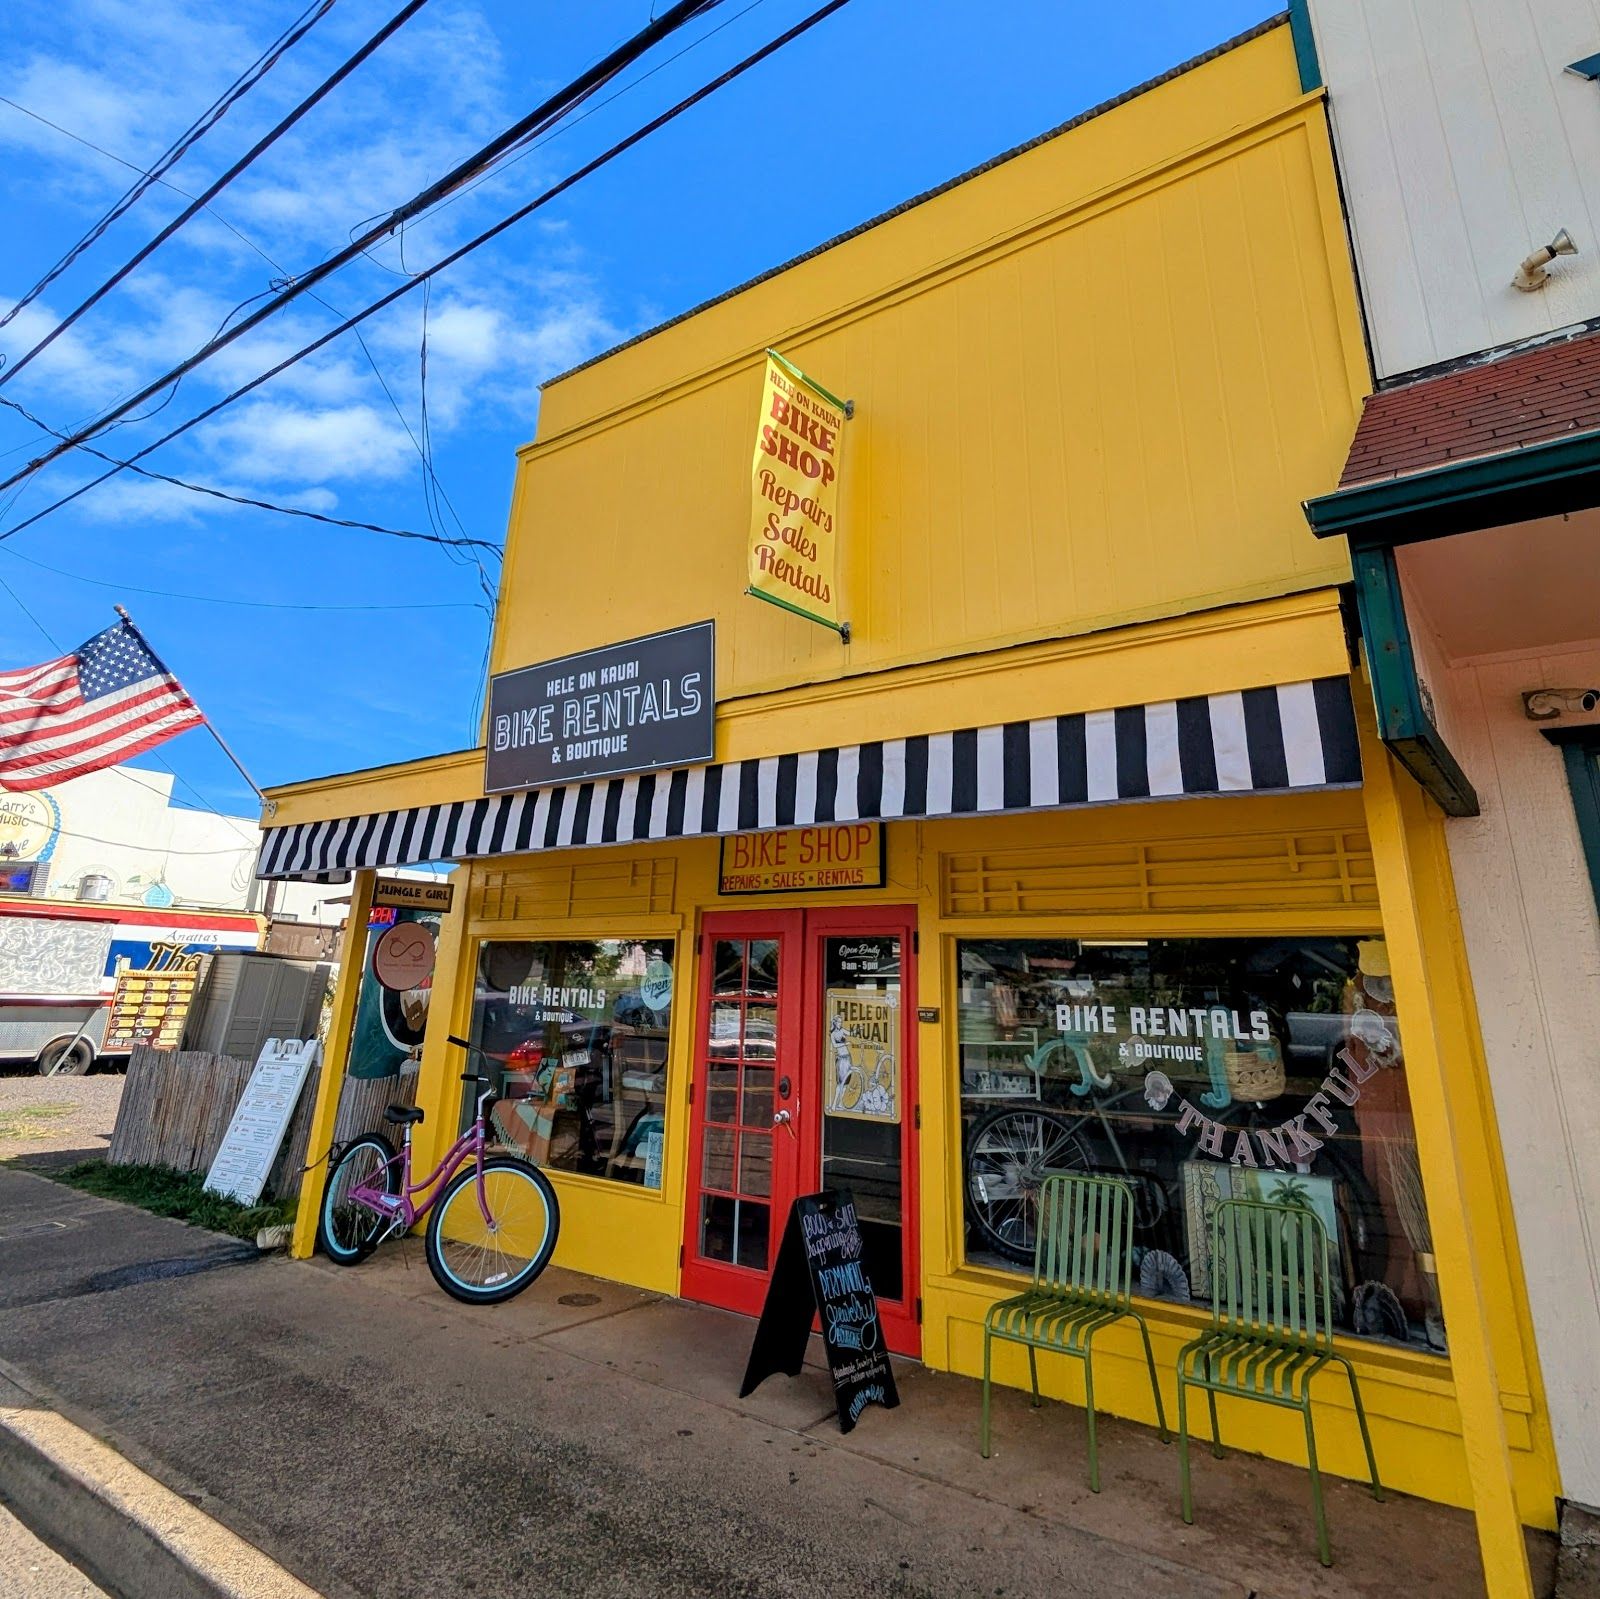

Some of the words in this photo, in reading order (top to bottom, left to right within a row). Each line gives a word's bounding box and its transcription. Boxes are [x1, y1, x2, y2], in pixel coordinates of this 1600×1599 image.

[770, 370, 796, 399] HELE
[796, 391, 811, 411] ON
[812, 401, 842, 431] KAUAI
[770, 391, 836, 457] BIKE
[760, 424, 835, 488] SHOP
[759, 469, 833, 534] Repairs
[763, 512, 817, 562] Sales
[754, 544, 831, 603] Rentals
[546, 675, 575, 698] HELE
[579, 670, 596, 690] ON
[600, 660, 640, 686] KAUAI
[494, 703, 556, 752] BIKE
[562, 671, 702, 739] RENTALS
[551, 746, 561, 764] &
[566, 734, 629, 762] BOUTIQUE
[0, 798, 36, 815] arry's
[732, 831, 789, 869] BIKE
[799, 823, 873, 864] SHOP
[378, 884, 422, 899] JUNGLE
[425, 889, 449, 902] GIRL
[722, 874, 761, 891] REPAIRS
[771, 871, 806, 889] SALES
[816, 869, 864, 886] RENTALS
[839, 944, 858, 958] Open
[858, 943, 881, 961] Daily
[841, 960, 857, 970] 9am
[862, 960, 879, 971] 5pm
[509, 985, 538, 1005] BIKE
[543, 986, 606, 1009] RENTALS
[644, 977, 670, 999] Open
[535, 1010, 541, 1021] &
[542, 1011, 574, 1024] BOUTIQUE
[836, 1000, 873, 1022] HELE
[875, 1005, 889, 1021] ON
[1056, 1004, 1118, 1034] BIKE
[1129, 1006, 1271, 1041] RENTALS
[849, 1021, 889, 1044] KAUAI
[1119, 1042, 1130, 1058] &
[1135, 1043, 1204, 1062] BOUTIQUE
[1174, 1046, 1380, 1168] THANKFUL
